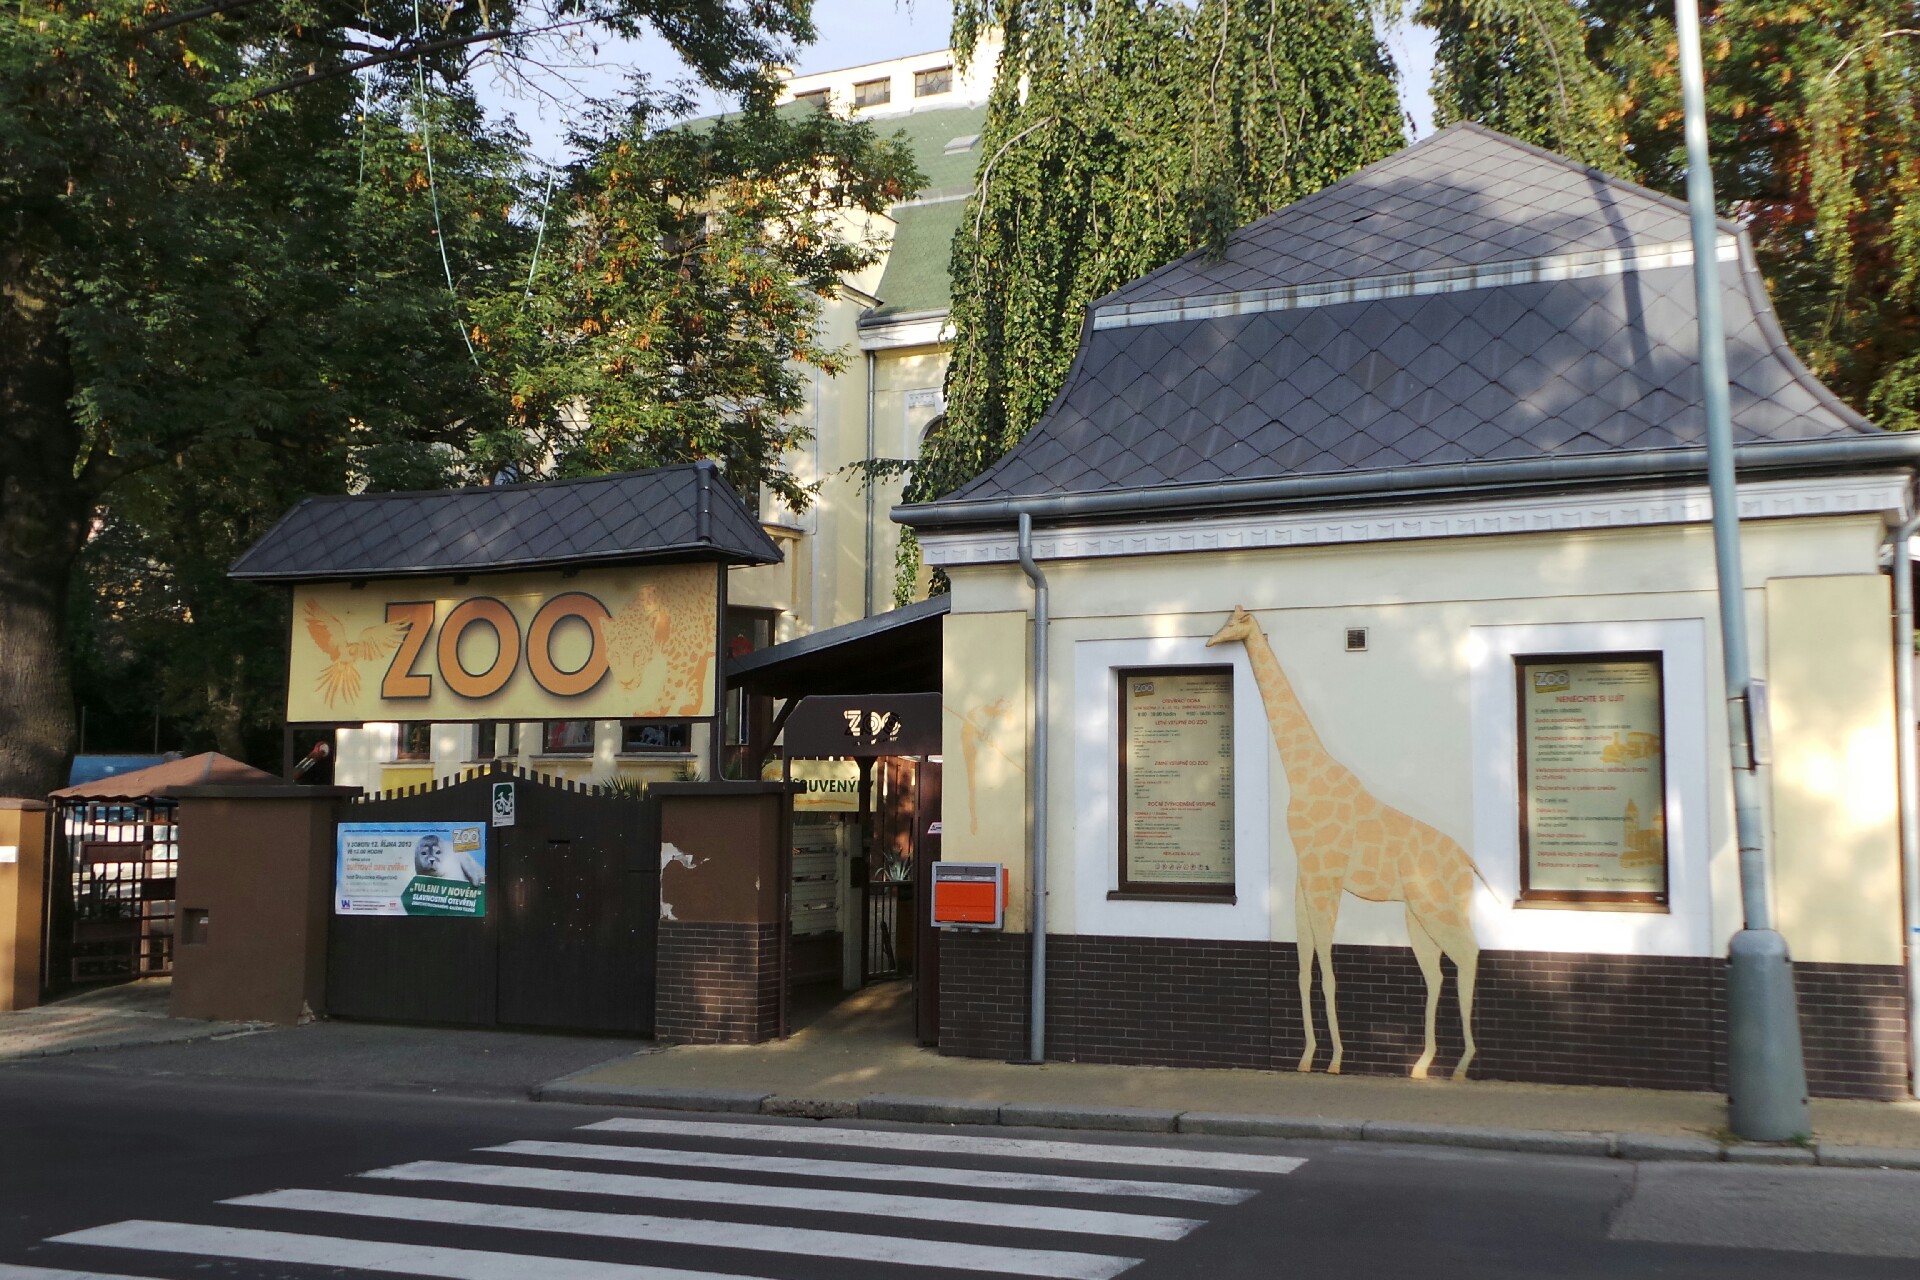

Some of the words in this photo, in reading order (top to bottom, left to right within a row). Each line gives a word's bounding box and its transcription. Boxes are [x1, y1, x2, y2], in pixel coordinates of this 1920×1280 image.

[381, 591, 614, 700] ZOO
[1535, 672, 1568, 686] ZOO
[1134, 684, 1154, 693] ZOO
[843, 709, 902, 737] ZOO
[453, 828, 480, 844] ZOO
[441, 886, 447, 895] V
[412, 893, 448, 904] SLAVNOSTNÍ
